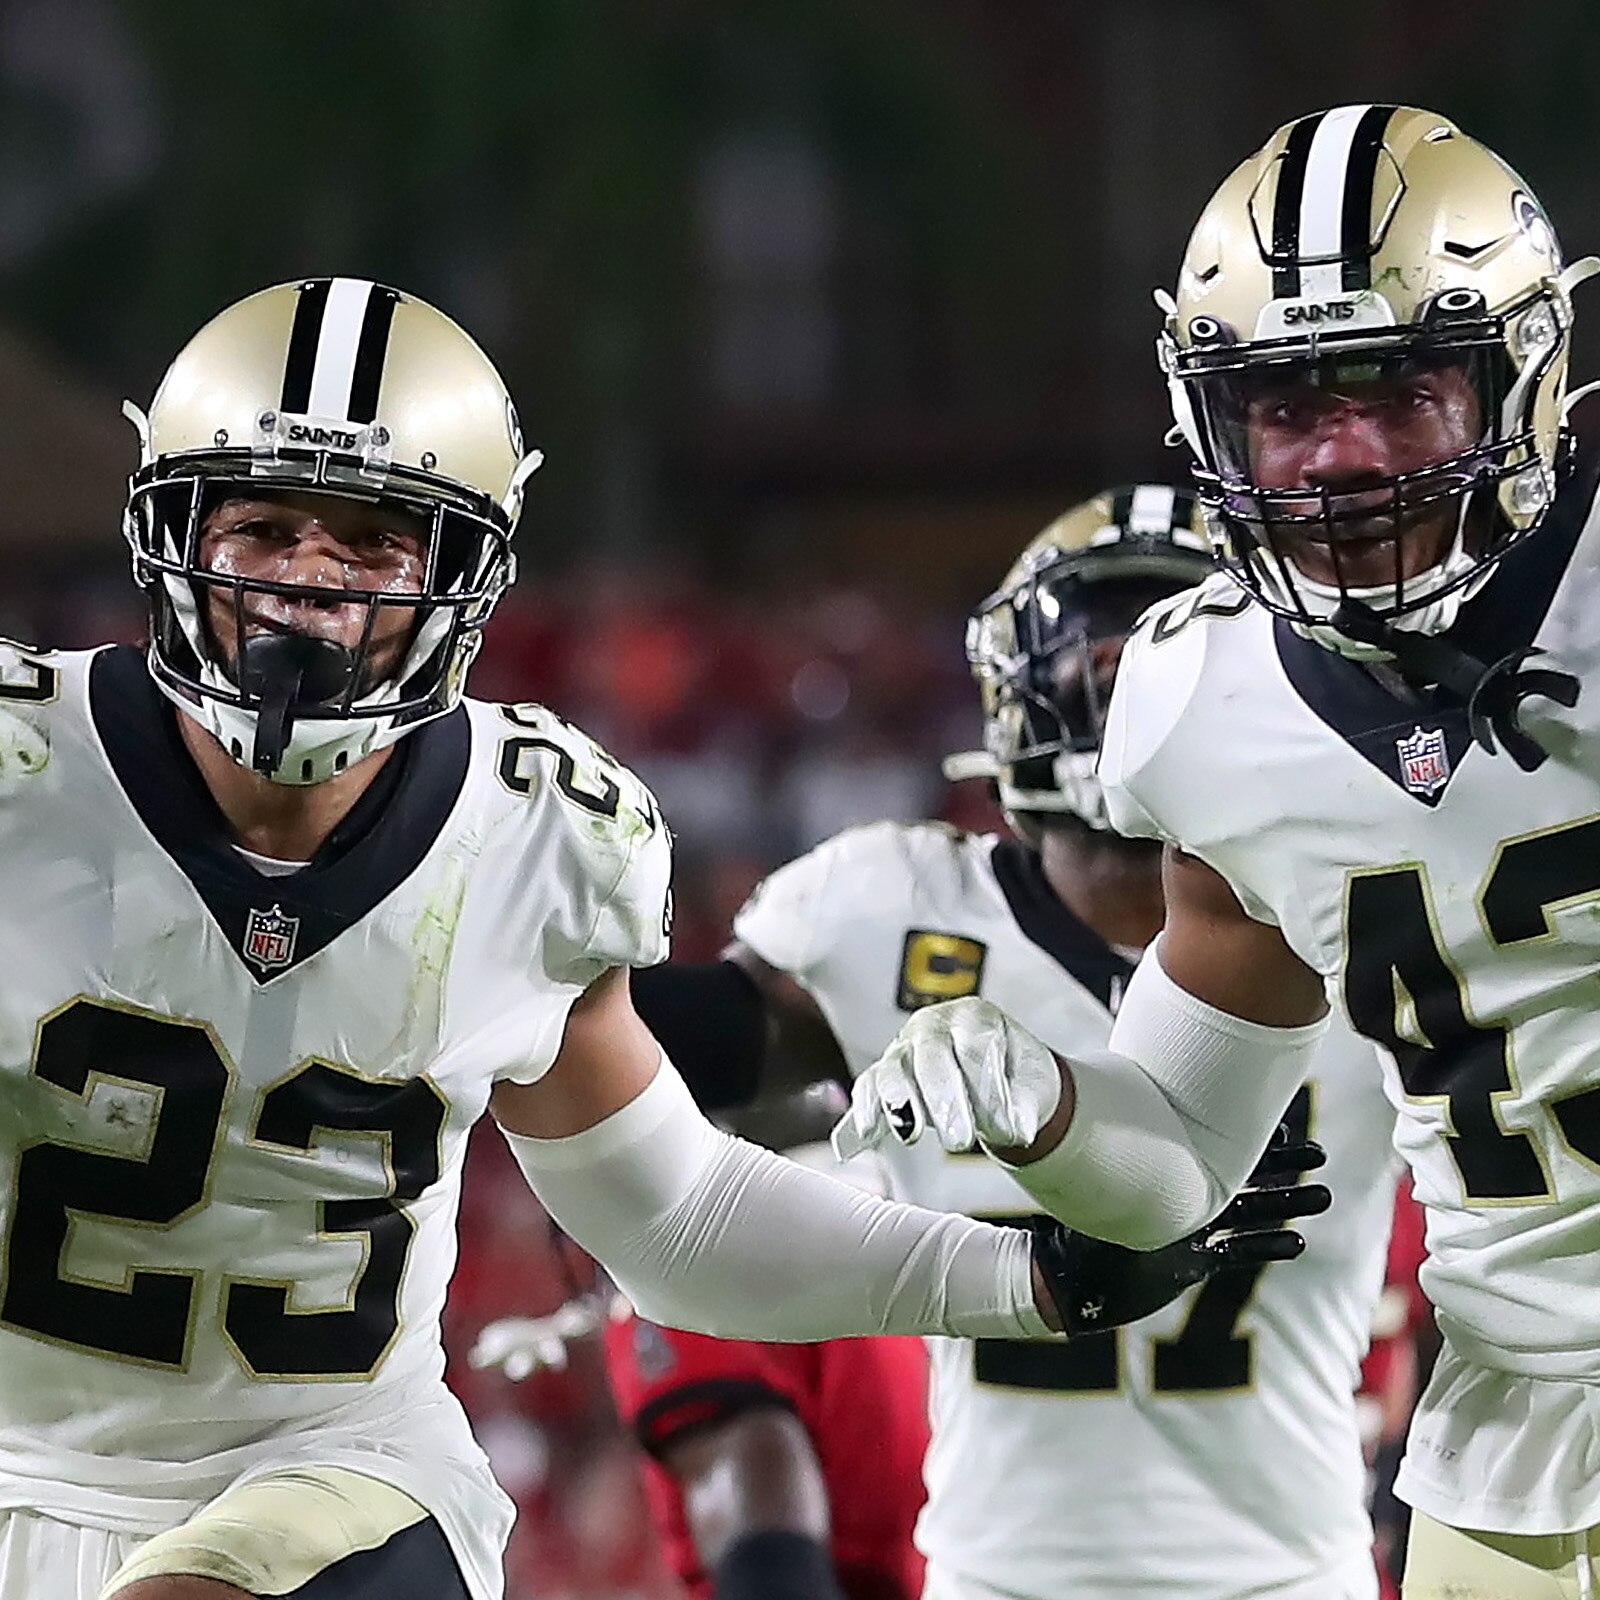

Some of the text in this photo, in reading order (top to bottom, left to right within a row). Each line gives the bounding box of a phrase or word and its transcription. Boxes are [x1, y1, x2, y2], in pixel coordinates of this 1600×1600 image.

[1283, 302, 1354, 324] SAINTS
[289, 425, 356, 449] SAINTS
[250, 933, 287, 960] NFL
[905, 932, 980, 996] C
